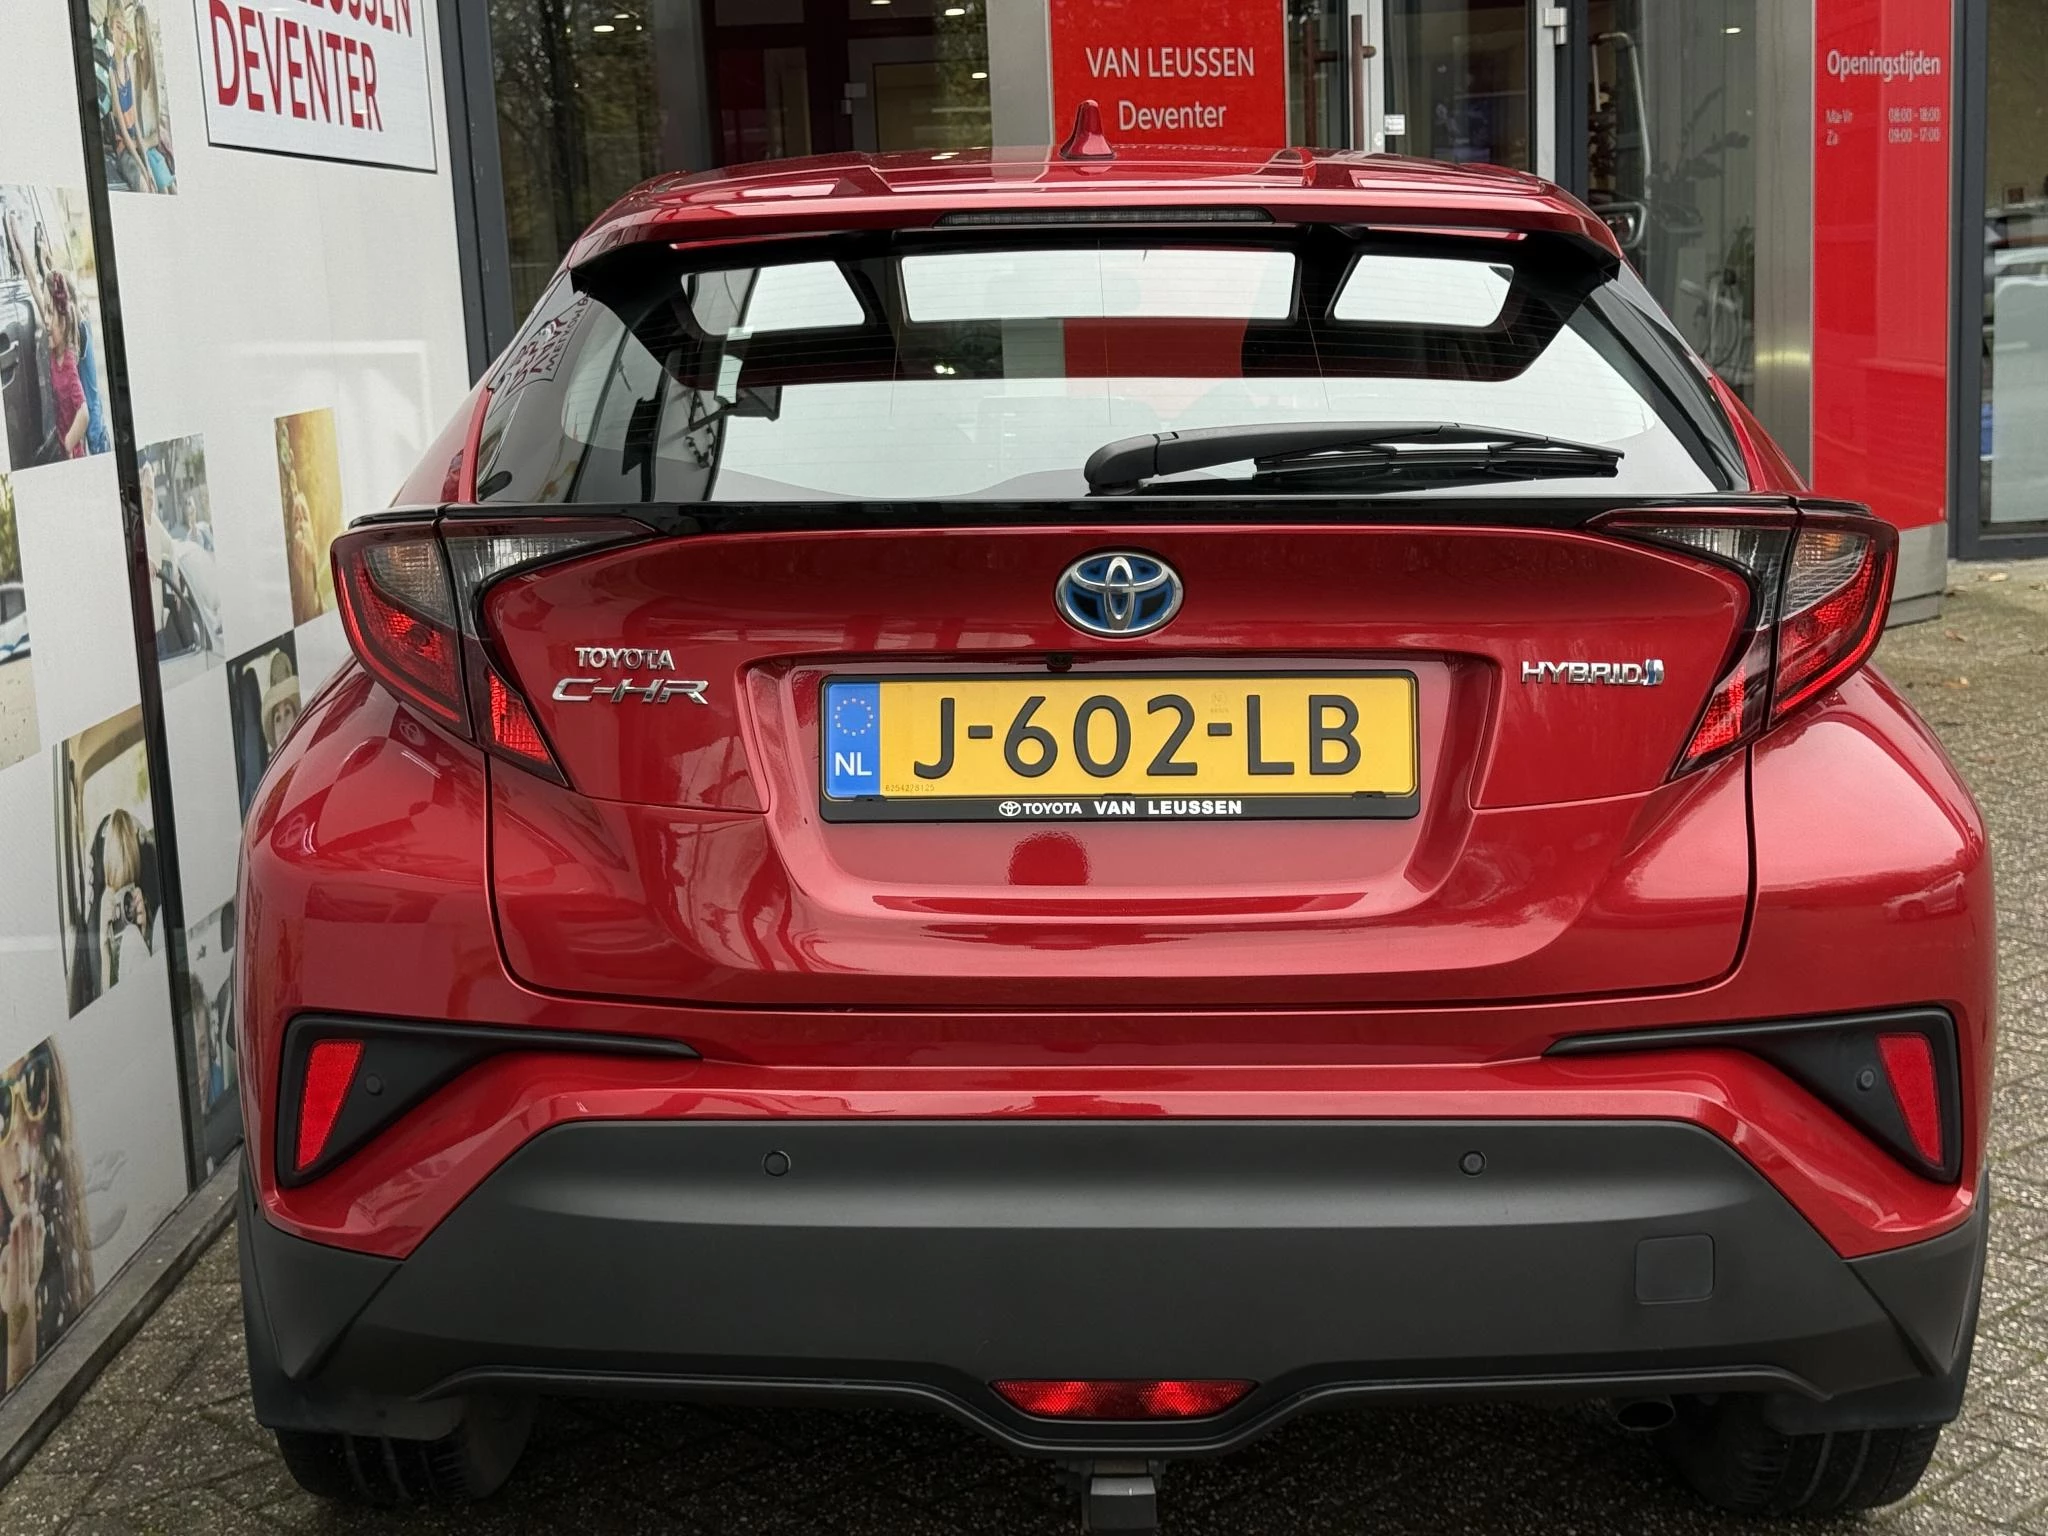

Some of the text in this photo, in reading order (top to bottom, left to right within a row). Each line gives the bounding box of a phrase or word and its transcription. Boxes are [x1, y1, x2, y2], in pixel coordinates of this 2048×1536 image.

[209, 0, 383, 132] DEVENTER
[1085, 47, 1255, 78] VAN LEUSSEN
[1826, 49, 1940, 82] Openingstijden
[1118, 100, 1227, 131] Deventer
[575, 647, 676, 671] TOYOTA
[1521, 660, 1642, 684] HYBRID
[552, 677, 709, 705] C-HR
[914, 694, 1361, 779] J-602-LB
[834, 752, 872, 776] NL
[1023, 800, 1242, 815] TOYOTA VAN LEUSSEN
